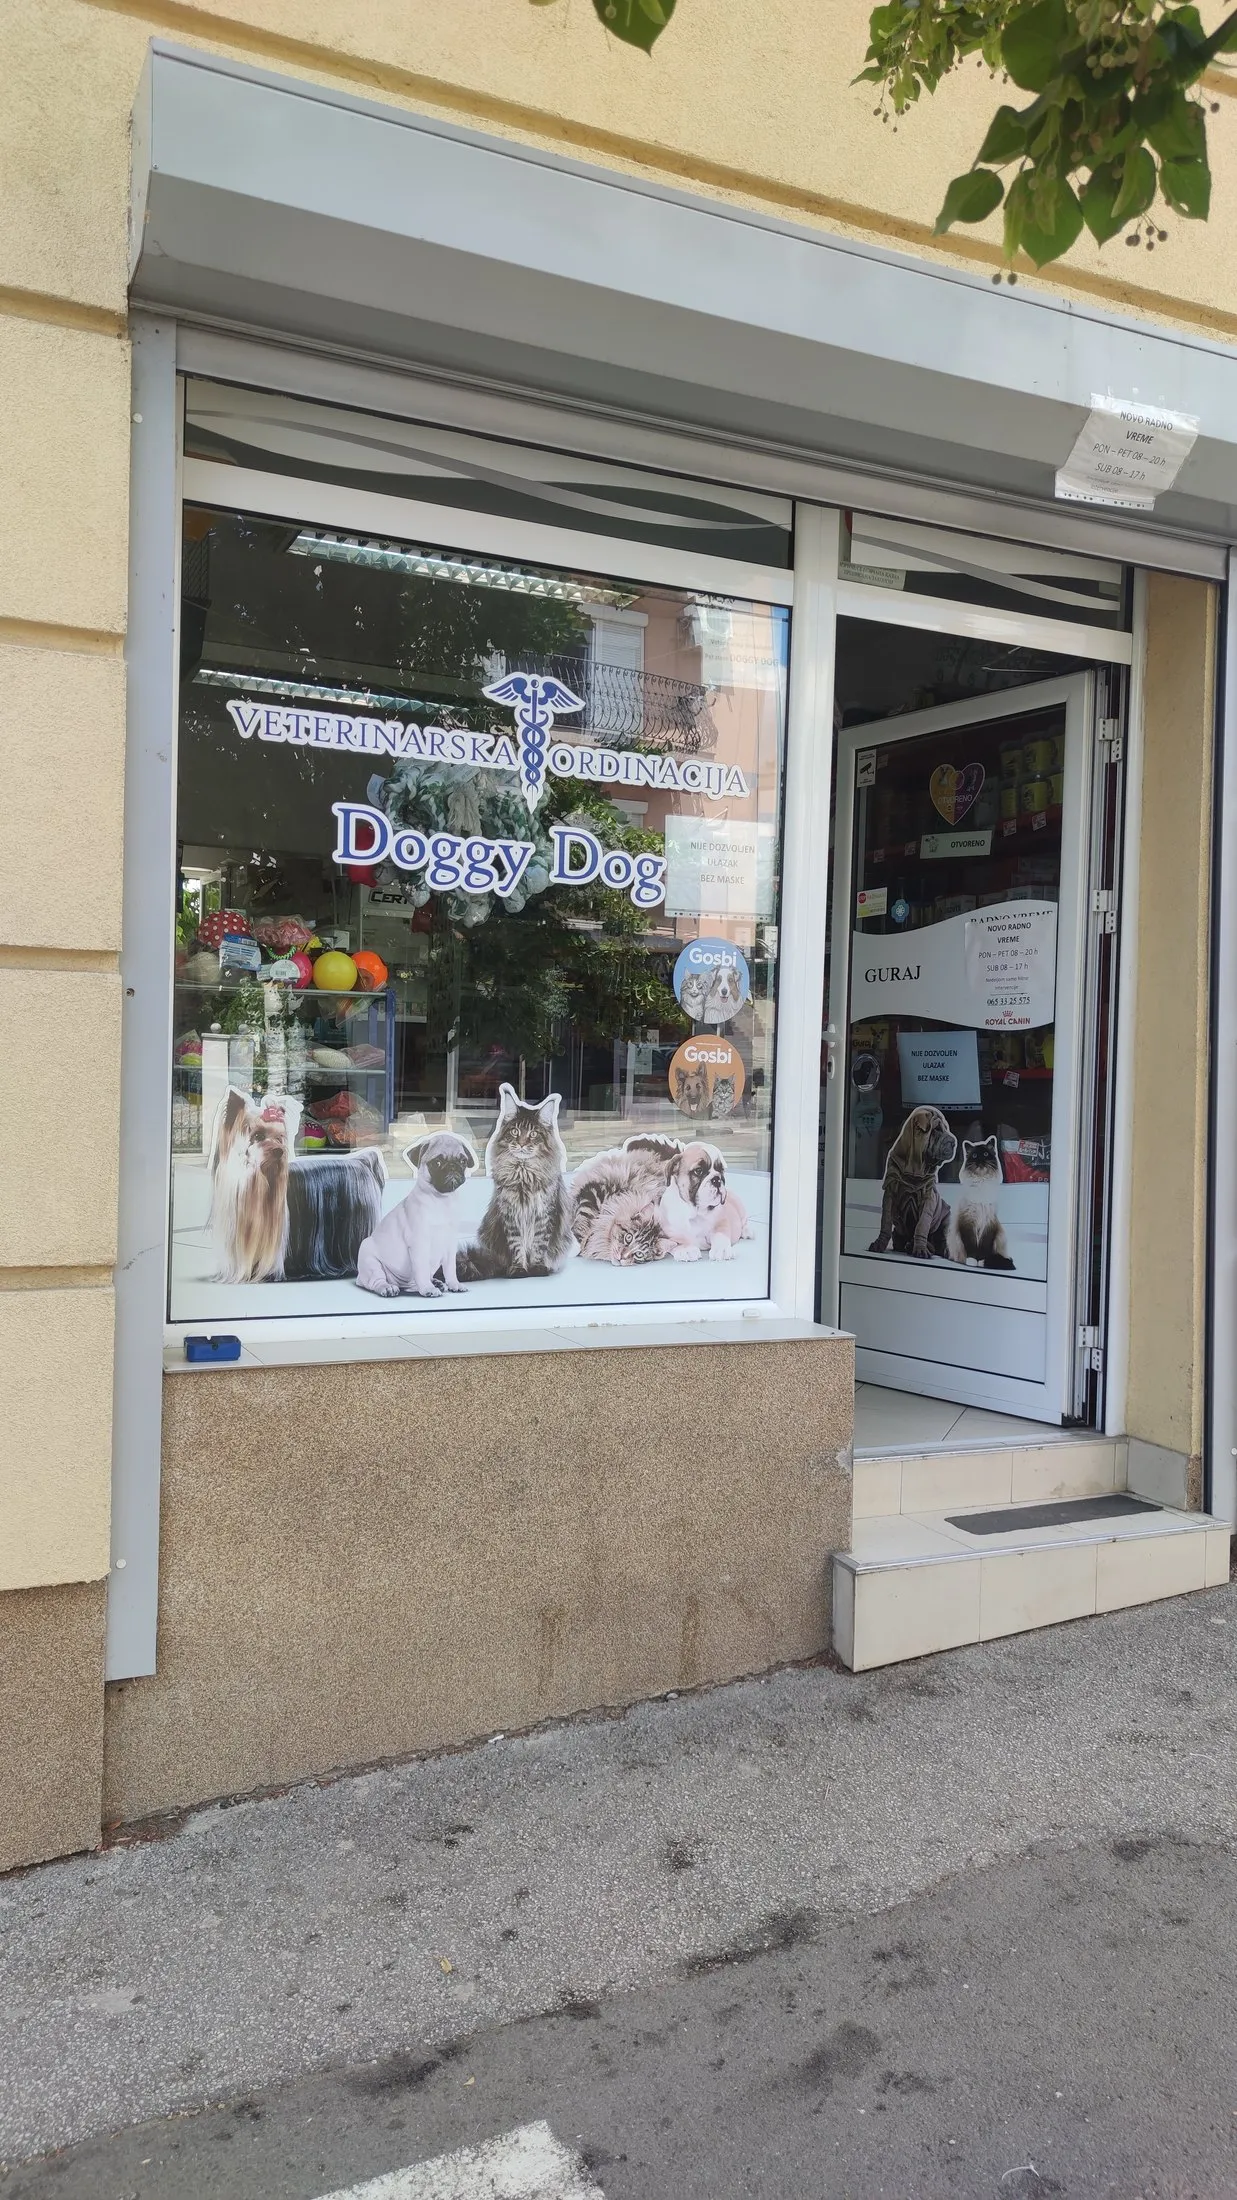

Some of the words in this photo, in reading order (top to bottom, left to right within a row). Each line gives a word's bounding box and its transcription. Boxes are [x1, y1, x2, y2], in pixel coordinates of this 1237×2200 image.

[1120, 411, 1144, 424] NOVO
[1145, 416, 1173, 431] RADNO
[1126, 430, 1154, 444] VREME
[1093, 443, 1111, 454] PON
[1117, 448, 1133, 459] PET
[1132, 451, 1144, 461] 08
[1149, 455, 1160, 465] 20
[1160, 457, 1167, 467] h
[1095, 462, 1112, 473] SUB
[1112, 466, 1123, 476] 08
[1129, 470, 1140, 479] 17
[1140, 472, 1146, 480] h
[230, 703, 517, 767] VETERINARSKA
[551, 747, 746, 796] ORDINACIJA
[690, 842, 708, 851] NIJE
[709, 843, 756, 854] DOZVOLJEN
[950, 839, 986, 849] OTVORENO
[336, 806, 532, 892] Doggy
[553, 830, 664, 903] Dog
[707, 858, 739, 868] ULAZAK
[700, 874, 716, 883] BEZ
[717, 875, 745, 885] MASKE
[987, 924, 1007, 932] NOVO
[1008, 922, 1032, 930] RADNO
[997, 936, 1020, 944] VREME
[689, 948, 737, 967] Gosbi
[979, 951, 992, 959] PON
[998, 950, 1010, 958] PET
[1010, 949, 1019, 957] 08
[1025, 948, 1034, 956] 20
[987, 964, 999, 972] SUB
[864, 965, 922, 983] GURAJ
[986, 998, 999, 1006] 065
[1000, 998, 1008, 1006] 33
[1009, 997, 1017, 1006] 25
[1018, 996, 1031, 1005] 575
[985, 1018, 1007, 1026] ROYAL
[1008, 1017, 1031, 1025] CANIN
[684, 1046, 732, 1064] Gosbi
[924, 1049, 958, 1057] DOZVOLJEN
